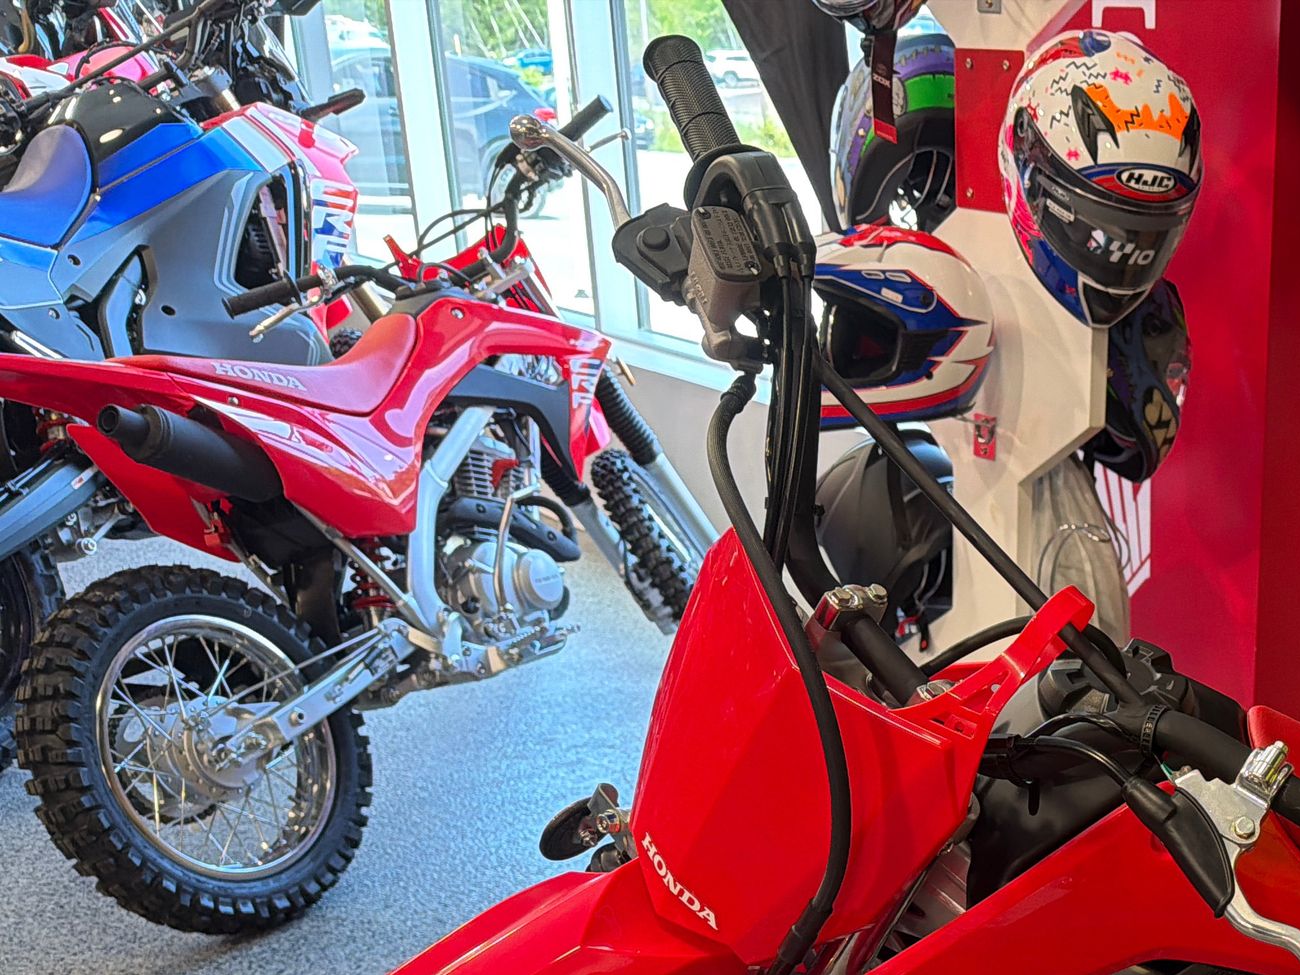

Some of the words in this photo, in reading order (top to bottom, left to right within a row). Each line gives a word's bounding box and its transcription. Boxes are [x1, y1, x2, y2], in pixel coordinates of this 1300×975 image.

[1125, 172, 1172, 188] HJC
[210, 361, 307, 392] HONDA
[641, 832, 719, 931] HONDA
